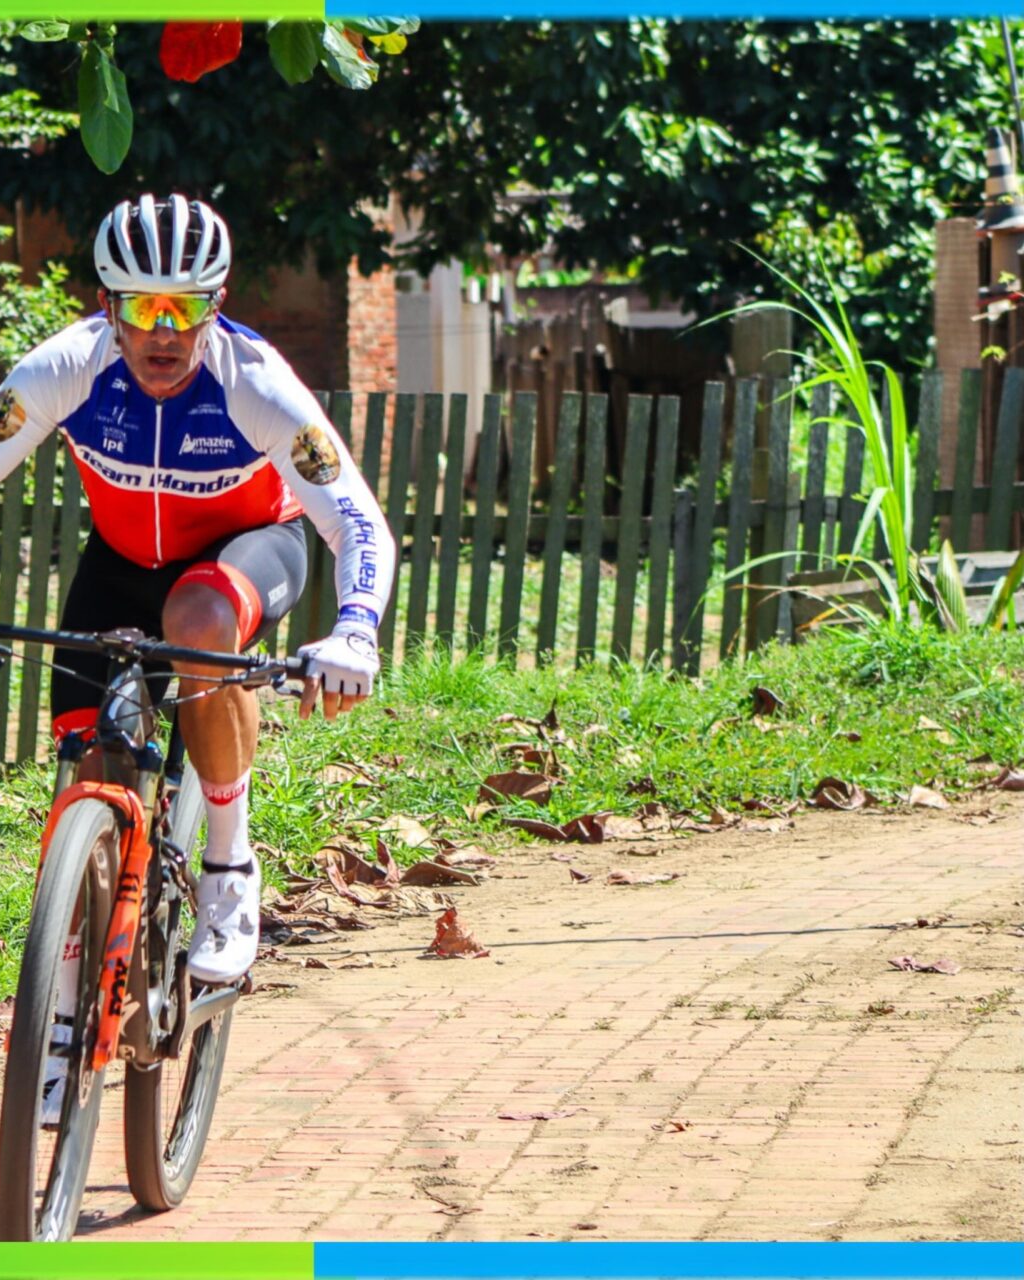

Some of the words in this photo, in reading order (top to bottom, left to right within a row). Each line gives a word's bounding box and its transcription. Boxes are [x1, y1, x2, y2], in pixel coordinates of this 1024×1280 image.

[79, 448, 142, 487] Team
[149, 472, 240, 495] Honda
[351, 550, 379, 595] Team
